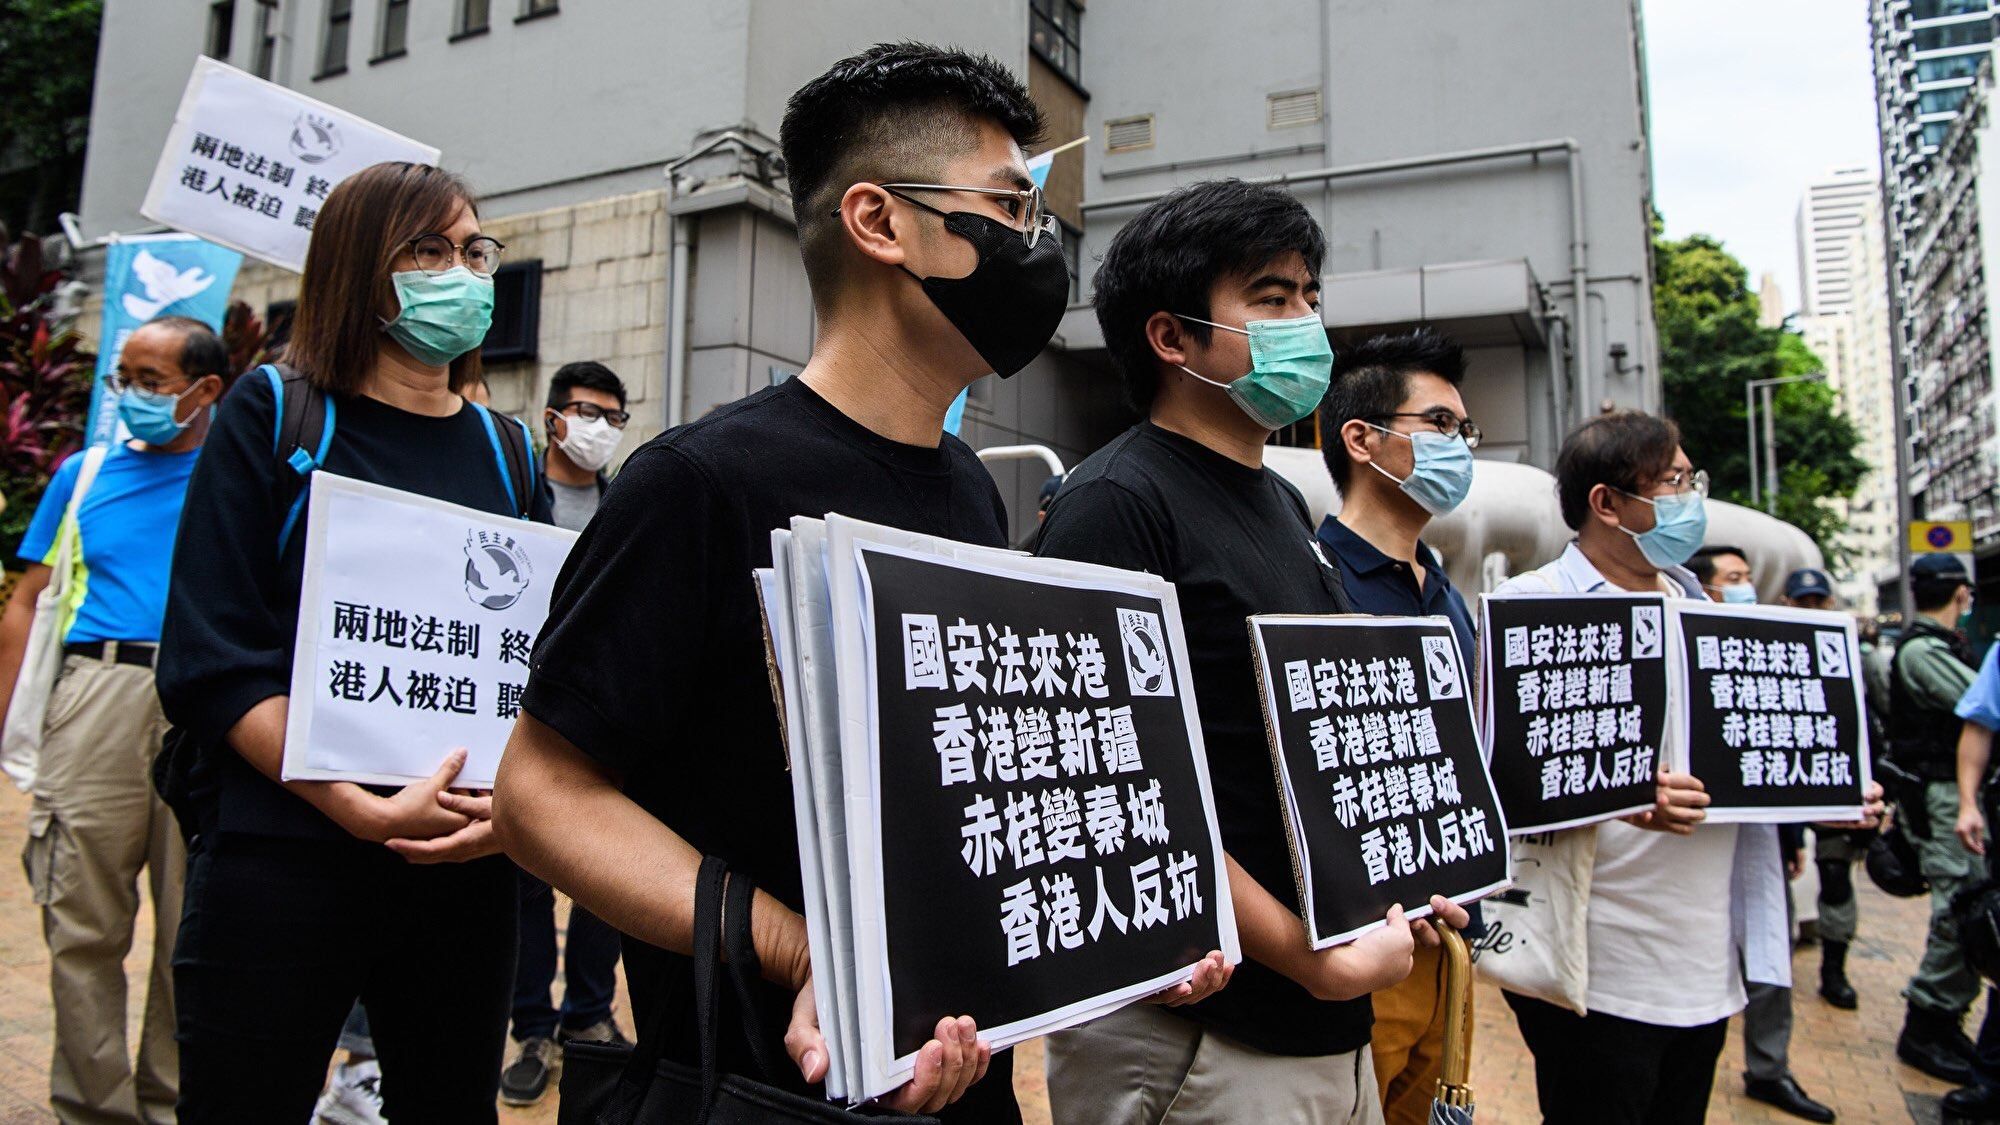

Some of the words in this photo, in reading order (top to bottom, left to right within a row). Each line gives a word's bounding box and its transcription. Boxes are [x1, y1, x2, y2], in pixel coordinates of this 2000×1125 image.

[191, 132, 294, 188] 兩地法制
[181, 165, 283, 219] 港人被迫
[334, 601, 480, 659] 兩地法制
[499, 628, 531, 668] 終
[902, 613, 1109, 698] 國安法來港
[1505, 623, 1622, 667] 國安法來港
[1696, 636, 1810, 676] 國安法來港
[330, 660, 476, 714] 港人被迫
[1285, 657, 1418, 712] 國安法來港
[1517, 664, 1632, 713] 香港變新疆
[1711, 674, 1826, 715] 香港變新疆
[933, 703, 1143, 786] 香港變新疆
[1309, 707, 1441, 771] 香港變新疆
[1526, 705, 1641, 756] 赤桂變秦城
[1723, 713, 1837, 753] 赤桂變秦城
[1333, 758, 1461, 828] 赤桂變秦城
[1541, 746, 1653, 800] 香港人反抗
[1740, 750, 1852, 786] 香港人反抗
[961, 779, 1169, 877] 赤桂變秦城
[1361, 807, 1494, 885] 香港人反抗
[1000, 851, 1202, 966] 香港人反抗
